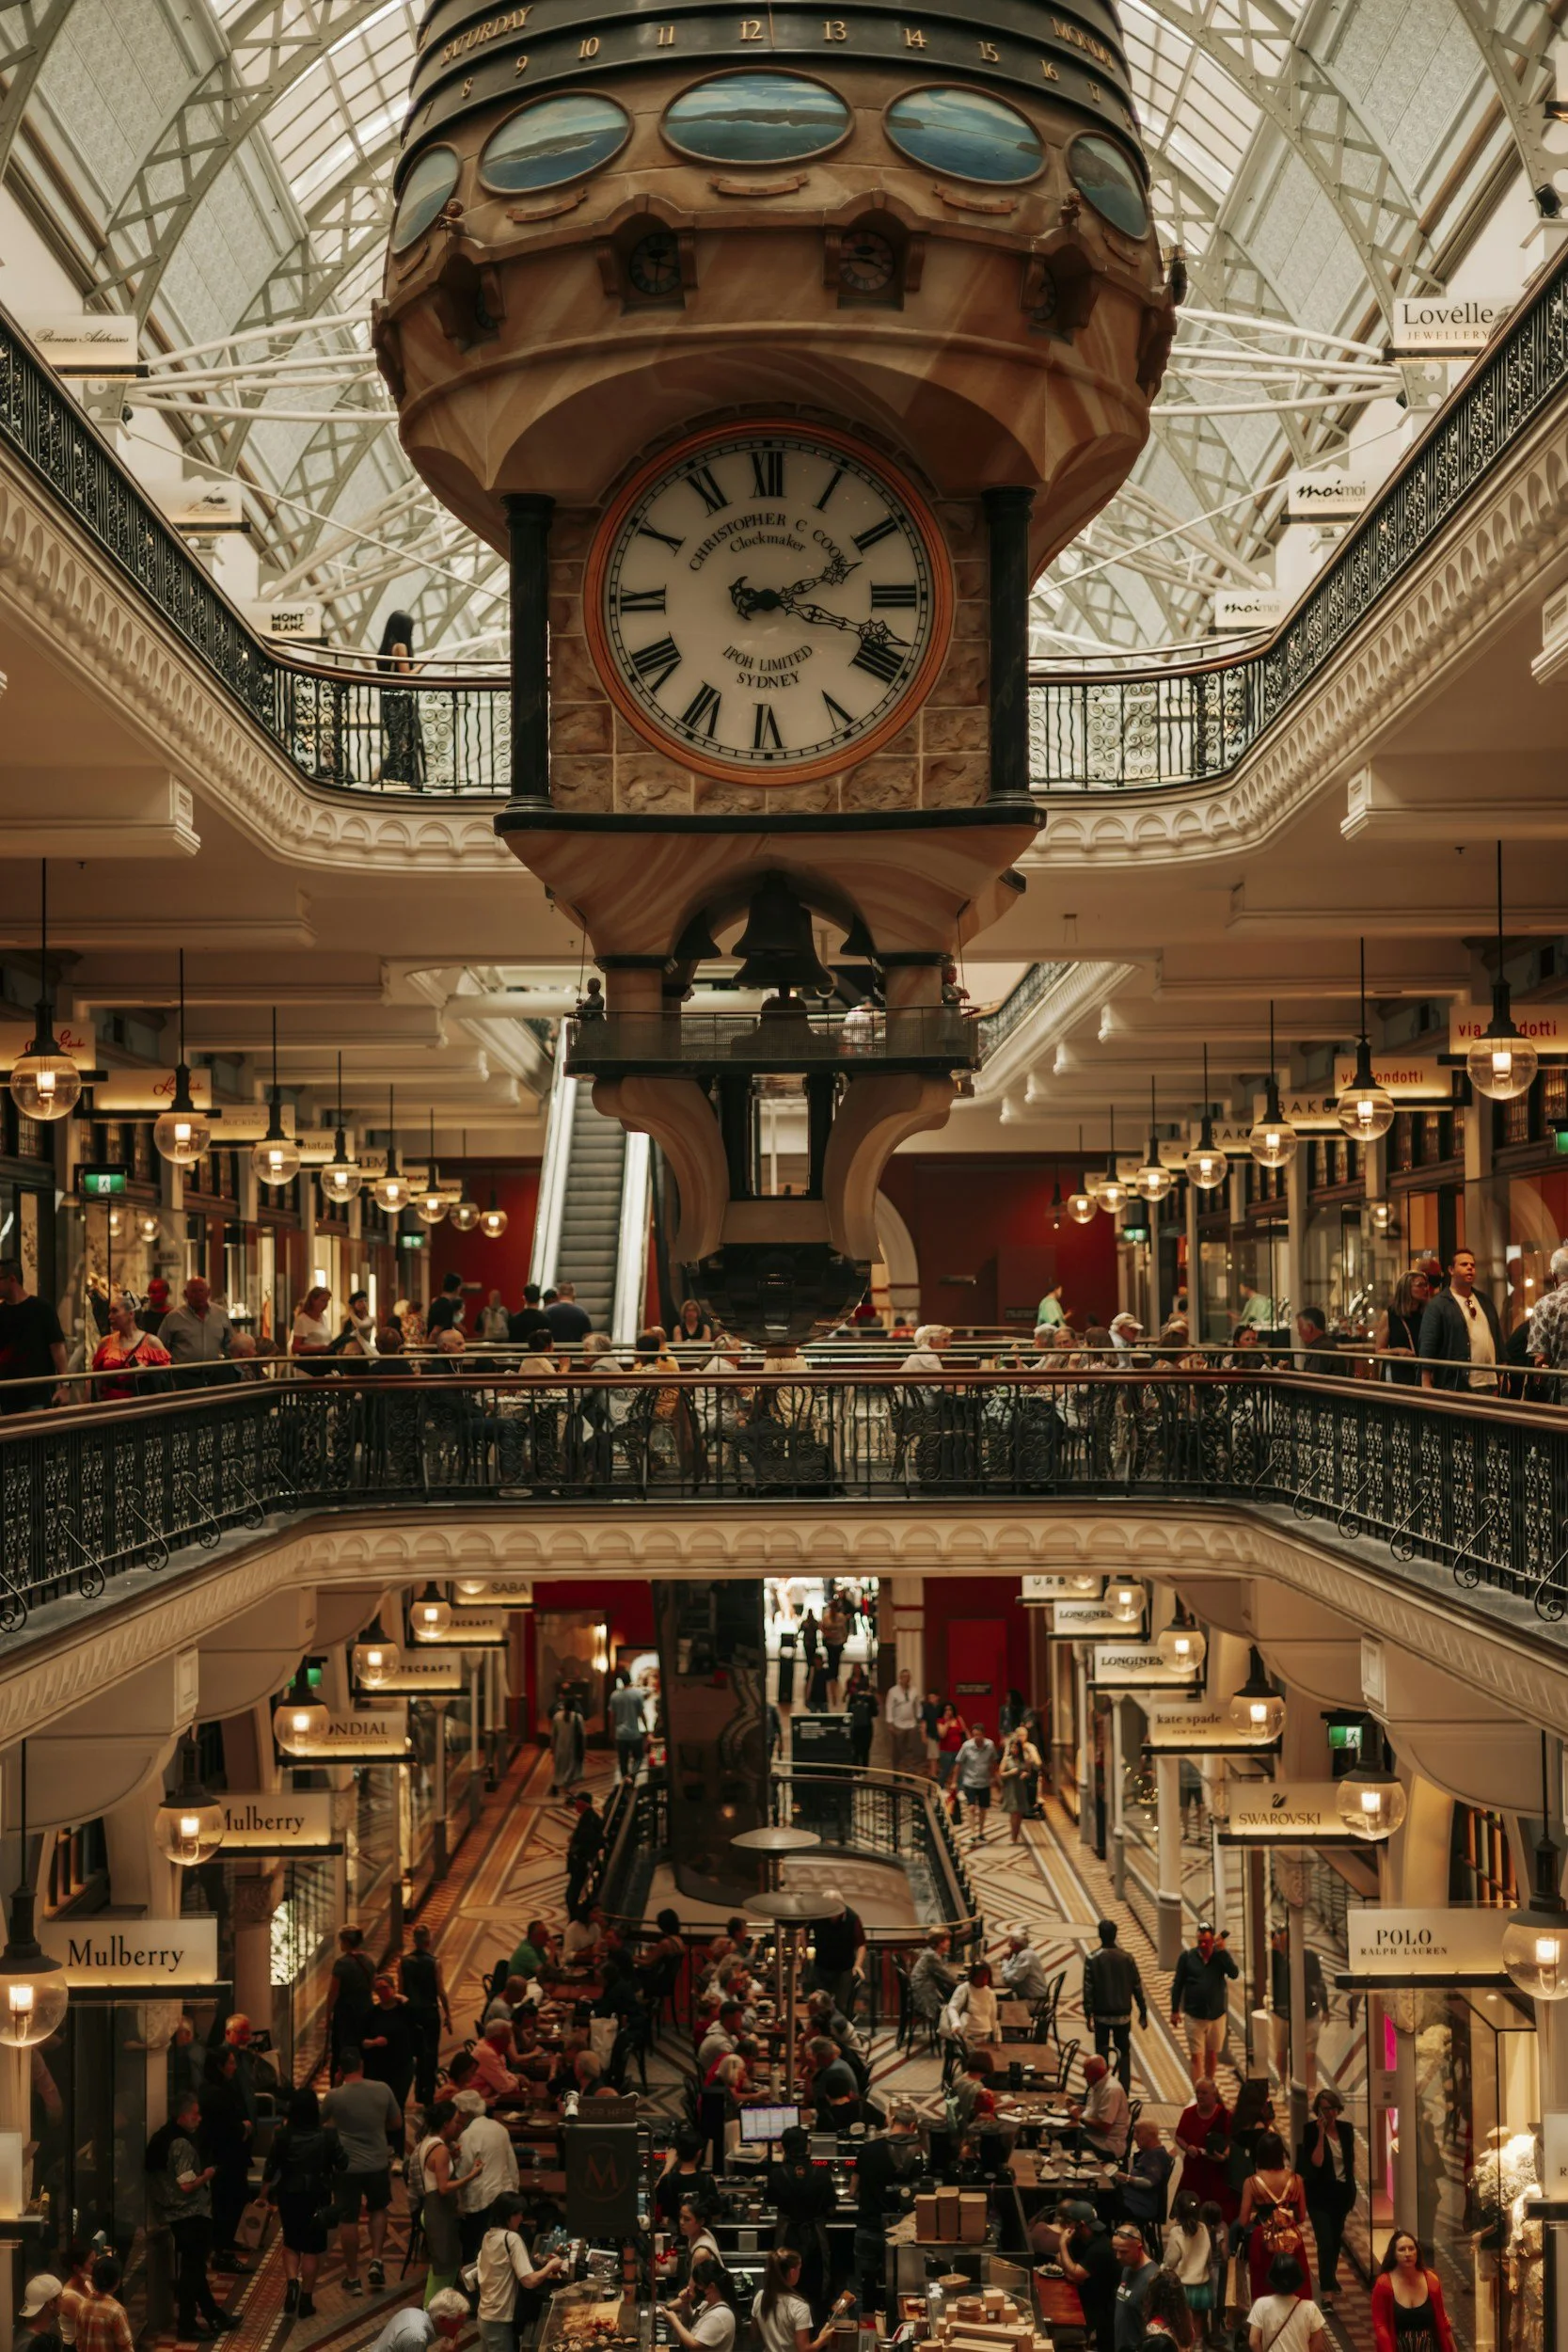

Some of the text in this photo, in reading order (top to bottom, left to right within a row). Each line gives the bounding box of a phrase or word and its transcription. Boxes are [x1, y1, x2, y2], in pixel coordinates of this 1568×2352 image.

[440, 6, 533, 68] SATURDAY
[461, 77, 473, 100] 8
[515, 56, 528, 78] 9
[578, 37, 599, 60] 10
[657, 25, 675, 47] 11
[739, 20, 763, 44] 12
[822, 20, 847, 44] 13
[903, 27, 927, 51] 14
[977, 41, 1000, 64] 15
[1040, 59, 1059, 82] 16
[1402, 302, 1494, 325] Lovélle
[1407, 330, 1488, 341] JEWELLERY
[750, 451, 786, 499] XII
[682, 465, 733, 517] XI
[813, 468, 847, 513] I
[635, 517, 686, 557] X
[689, 513, 786, 571] CHRISTOPHER
[796, 519, 808, 532] C
[730, 532, 806, 552] Clockmaker
[850, 515, 901, 556] II
[620, 584, 667, 615] IX
[870, 580, 917, 612] III
[272, 613, 304, 622] MONT
[722, 645, 813, 672] IPOH LIMITED
[737, 671, 800, 689] SYDNEY
[822, 690, 858, 734] V
[752, 704, 787, 749] VI
[1459, 1022, 1481, 1037] via
[1370, 1071, 1423, 1084] ondotti
[1212, 1128, 1246, 1139] BAK
[492, 1582, 528, 1594] SABA
[1101, 1656, 1164, 1665] LONGINES
[1156, 1713, 1222, 1726] kate spade
[1239, 1812, 1322, 1825] SWAROVSKI
[1376, 1929, 1433, 1946] POLO
[68, 1934, 184, 1973] Mulberry
[1404, 1947, 1448, 1955] LAUREN
